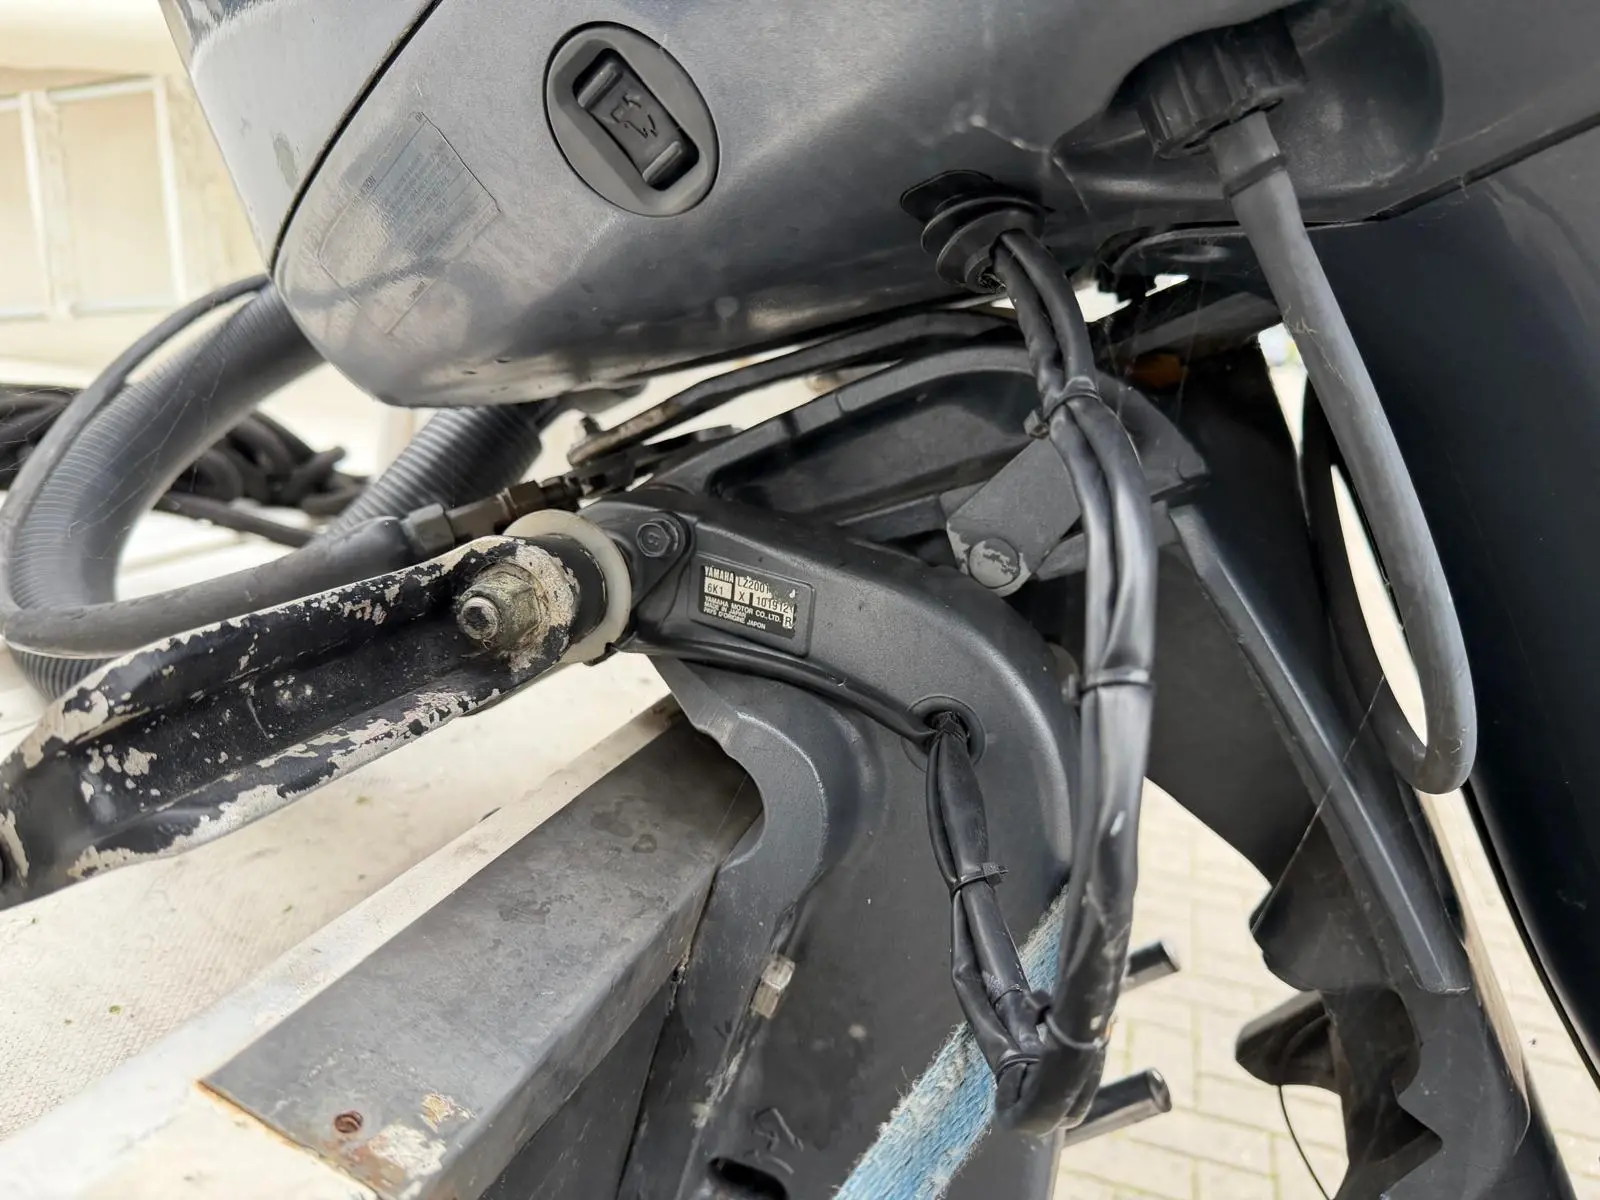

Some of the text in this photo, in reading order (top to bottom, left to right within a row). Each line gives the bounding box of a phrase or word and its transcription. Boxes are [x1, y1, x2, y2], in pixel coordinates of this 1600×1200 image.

[704, 566, 734, 584] YAMAHA
[707, 582, 723, 595] 6K1
[738, 591, 746, 602] X
[704, 595, 729, 607] YAMAHA
[731, 602, 754, 614] MOTOR
[747, 619, 766, 630] JAPON
[784, 616, 793, 628] R
